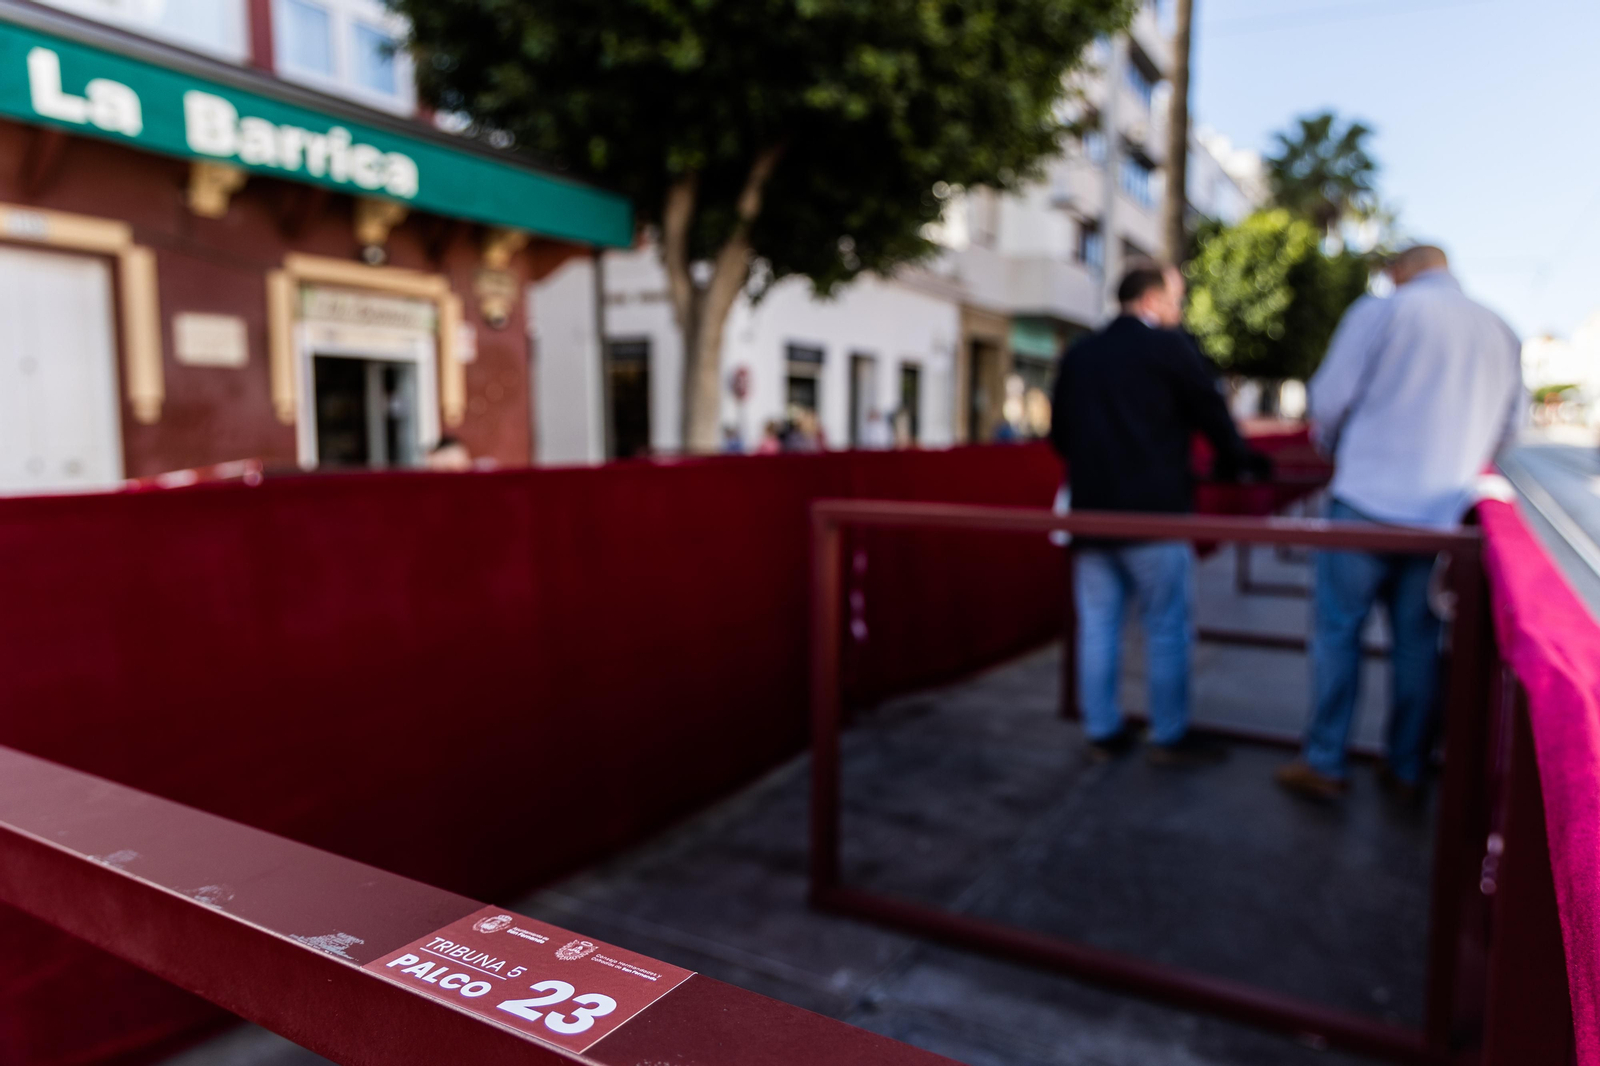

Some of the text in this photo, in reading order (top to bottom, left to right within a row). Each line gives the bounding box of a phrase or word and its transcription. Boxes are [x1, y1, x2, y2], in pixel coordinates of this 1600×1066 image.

[27, 46, 420, 199] La Barrica
[386, 953, 617, 1034] PALCO 23
[426, 937, 527, 978] TRIBUNA 5
